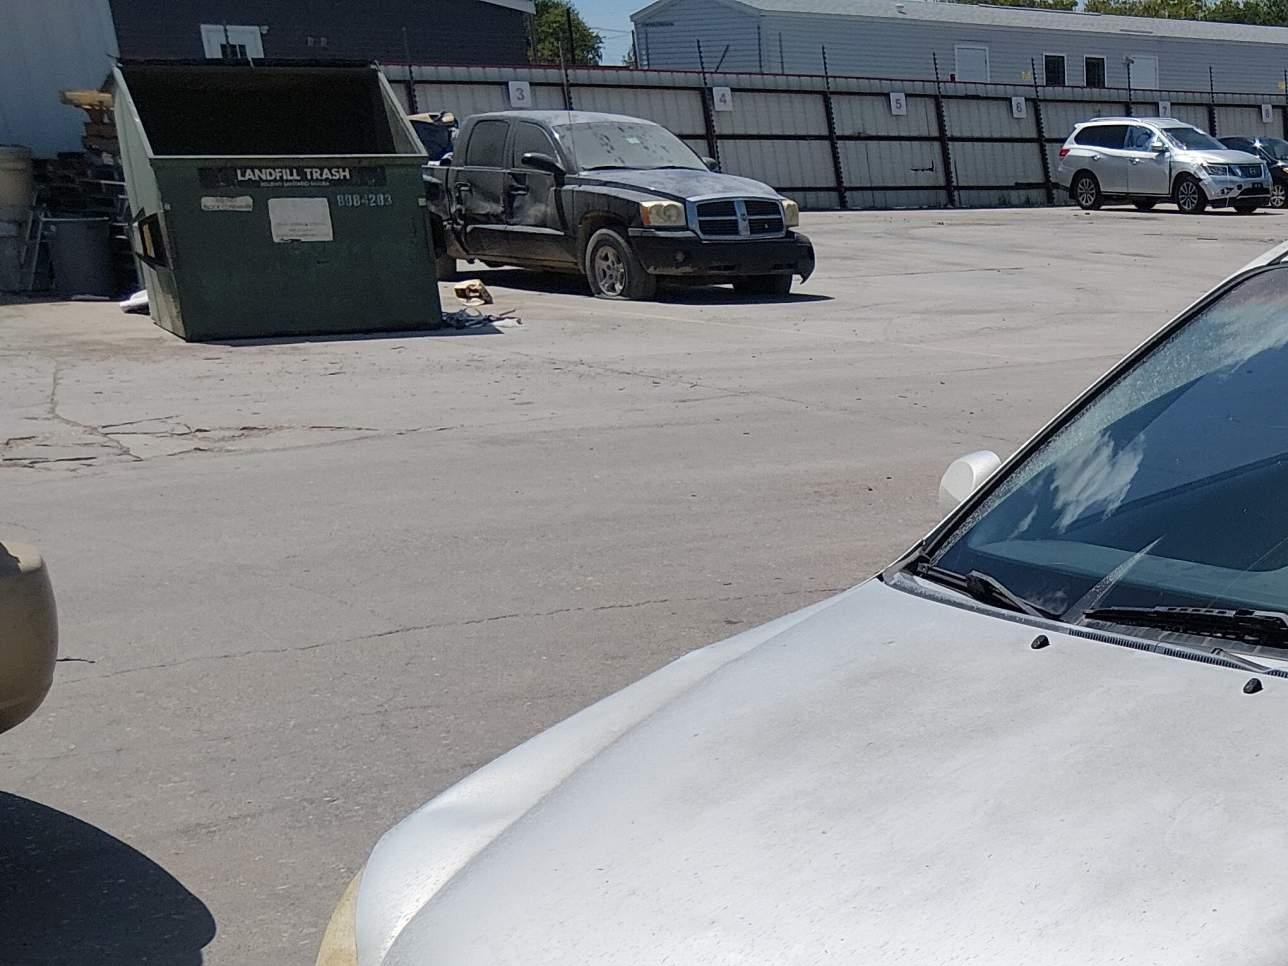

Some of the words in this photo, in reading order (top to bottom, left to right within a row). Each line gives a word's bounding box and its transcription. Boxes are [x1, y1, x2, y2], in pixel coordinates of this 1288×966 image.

[515, 87, 525, 101] 3
[719, 92, 727, 105] 4
[895, 98, 902, 110] 5
[236, 168, 301, 181] LANDFILL
[303, 167, 350, 180] TRASH
